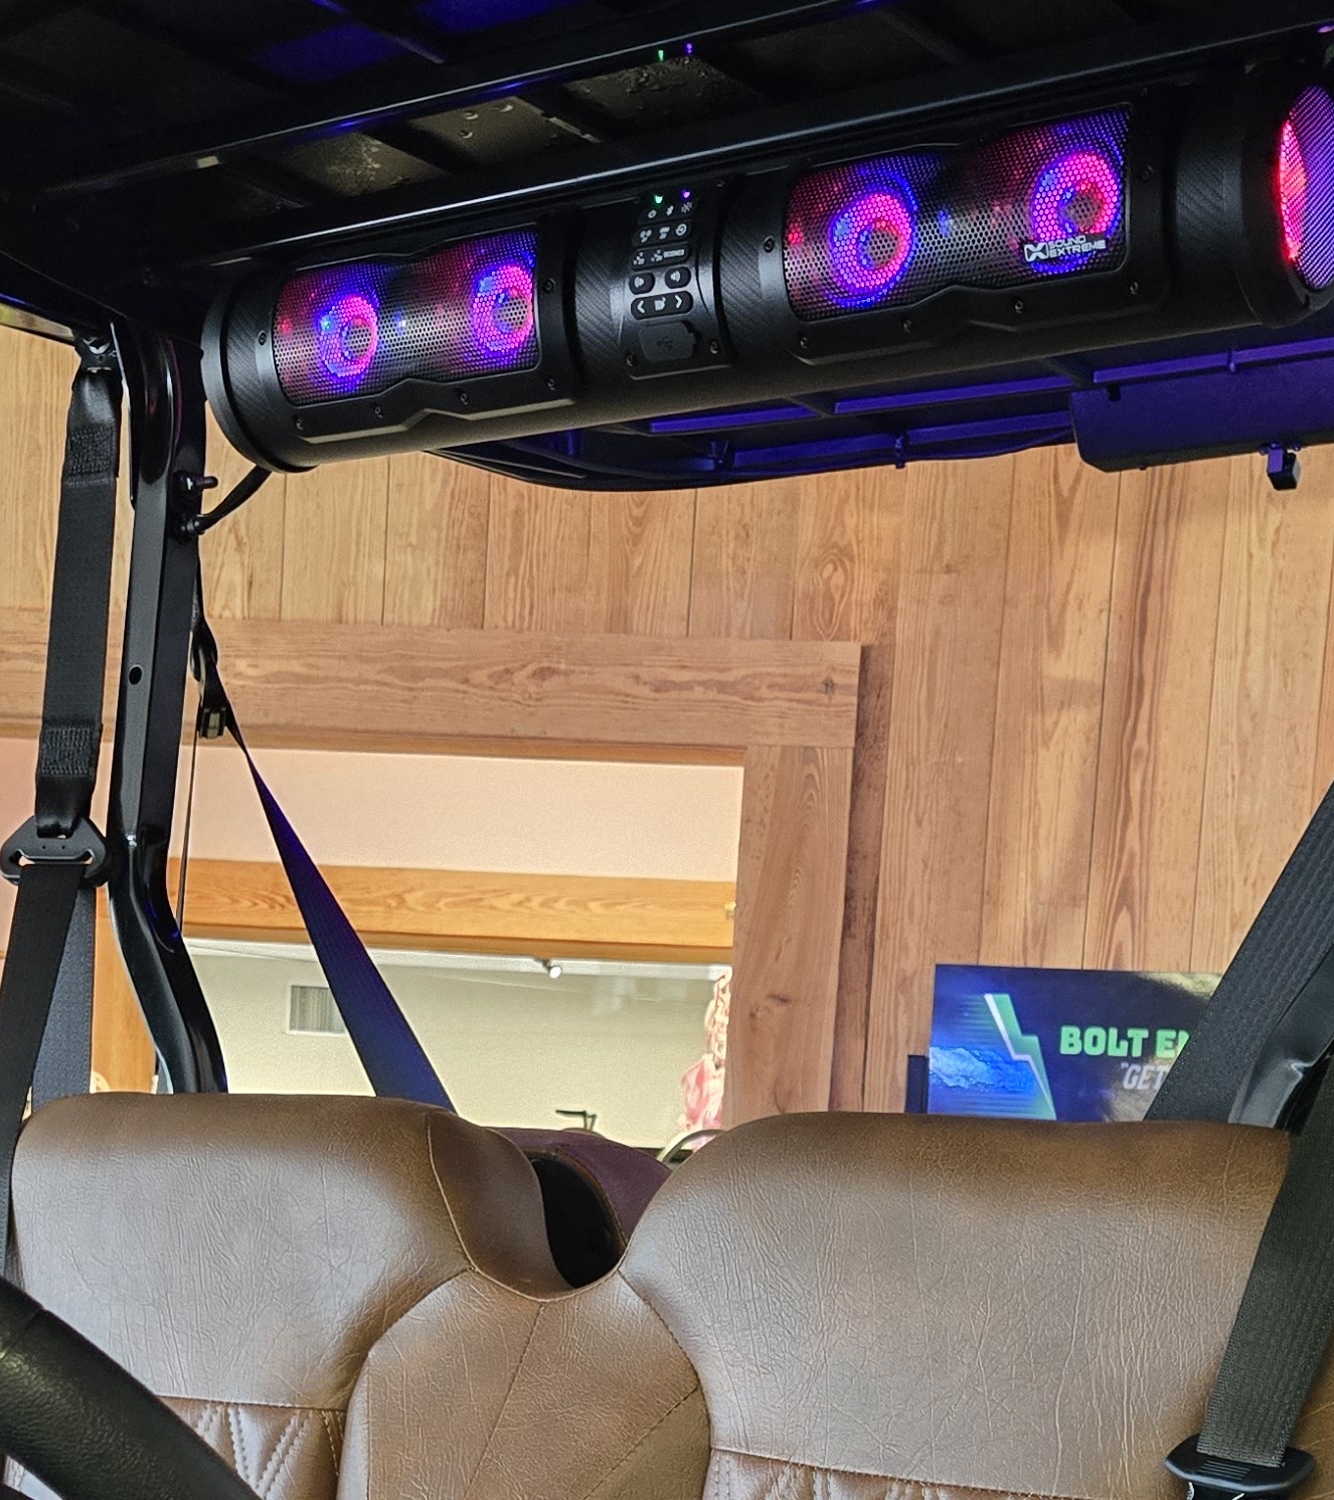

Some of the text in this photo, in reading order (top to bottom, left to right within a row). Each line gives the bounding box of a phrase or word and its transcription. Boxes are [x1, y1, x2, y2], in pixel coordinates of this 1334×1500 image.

[1048, 235, 1086, 249] SOUND
[1049, 240, 1106, 258] EXTREME
[1059, 1025, 1149, 1058] BOLT
